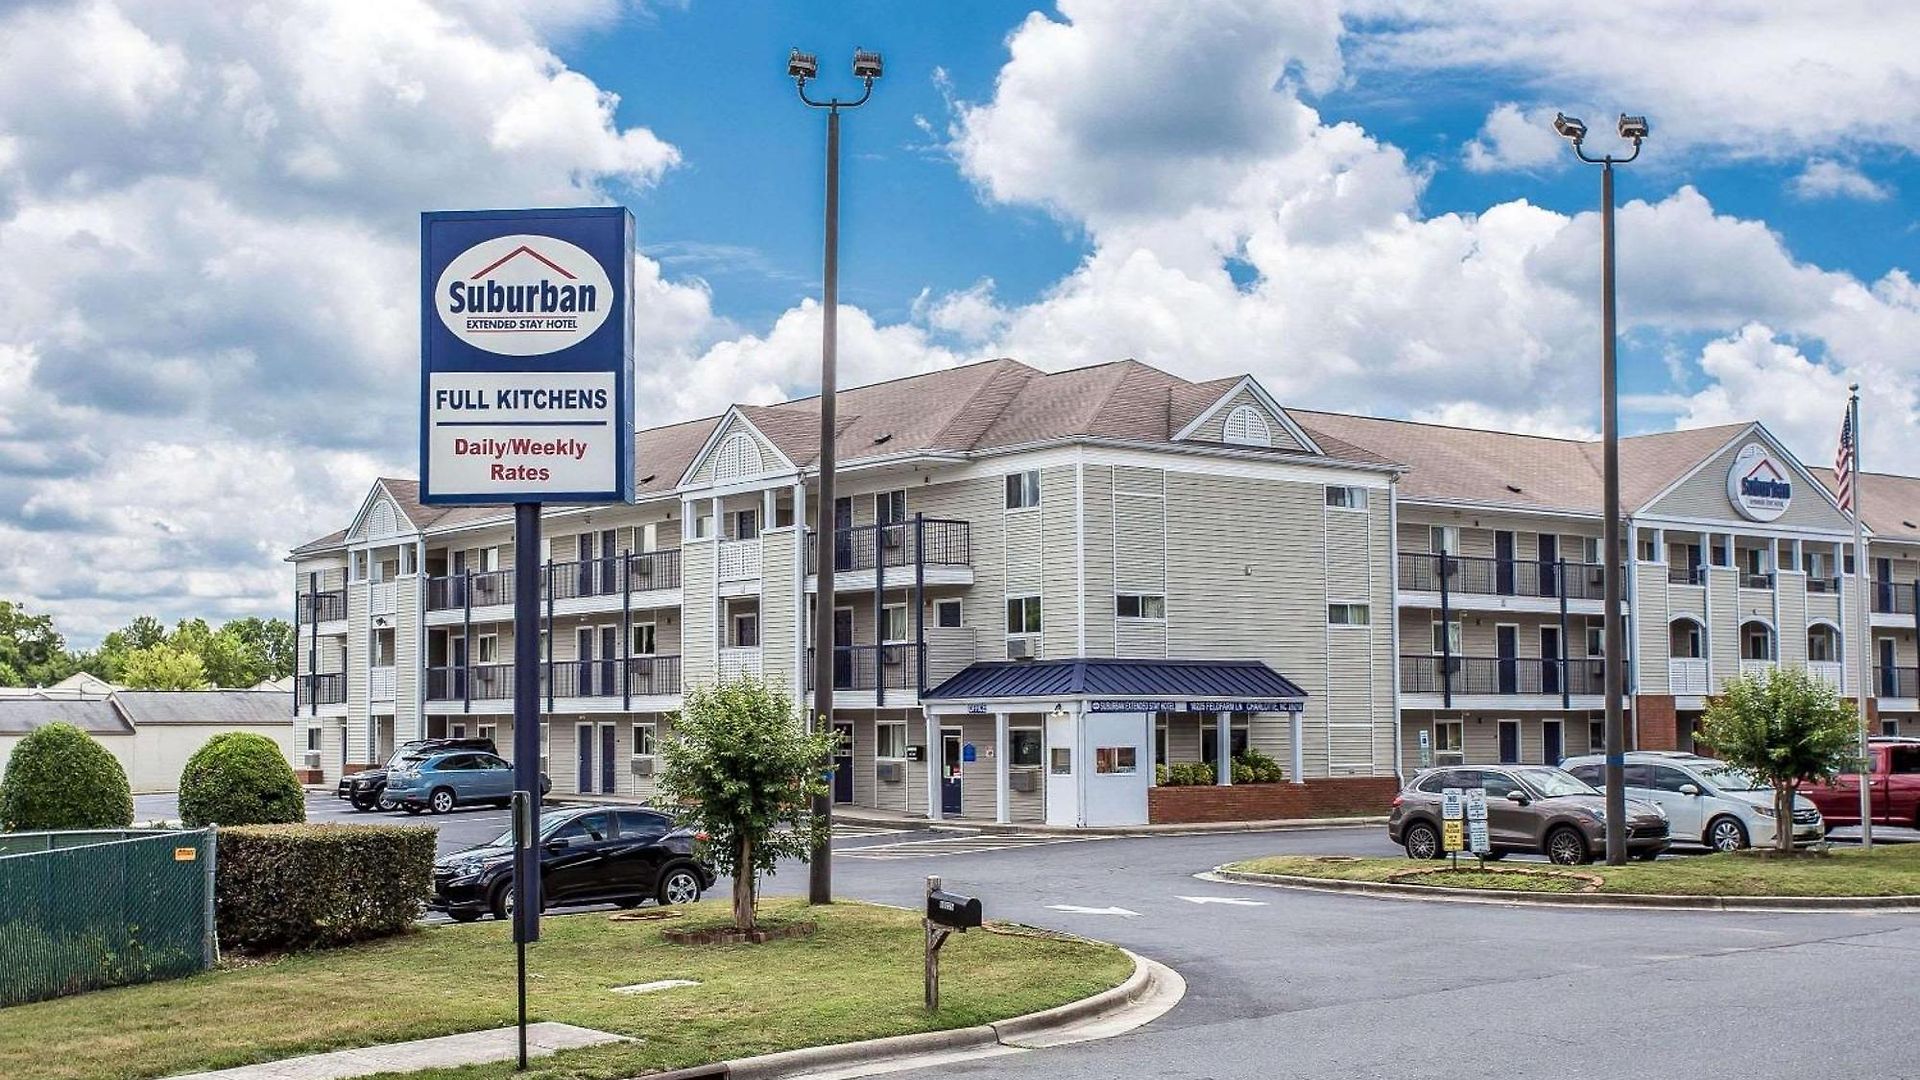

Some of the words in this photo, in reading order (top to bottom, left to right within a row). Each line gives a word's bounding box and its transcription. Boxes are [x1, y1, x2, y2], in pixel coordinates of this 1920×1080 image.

[450, 280, 596, 314] Suburban
[466, 319, 517, 330] EXTENDED
[519, 319, 543, 330] STAY
[545, 319, 578, 330] HOTEL
[436, 389, 490, 411] FULL
[496, 388, 608, 410] KITCHENS
[455, 438, 588, 460] Daily/Weekly
[490, 464, 551, 482] Rates
